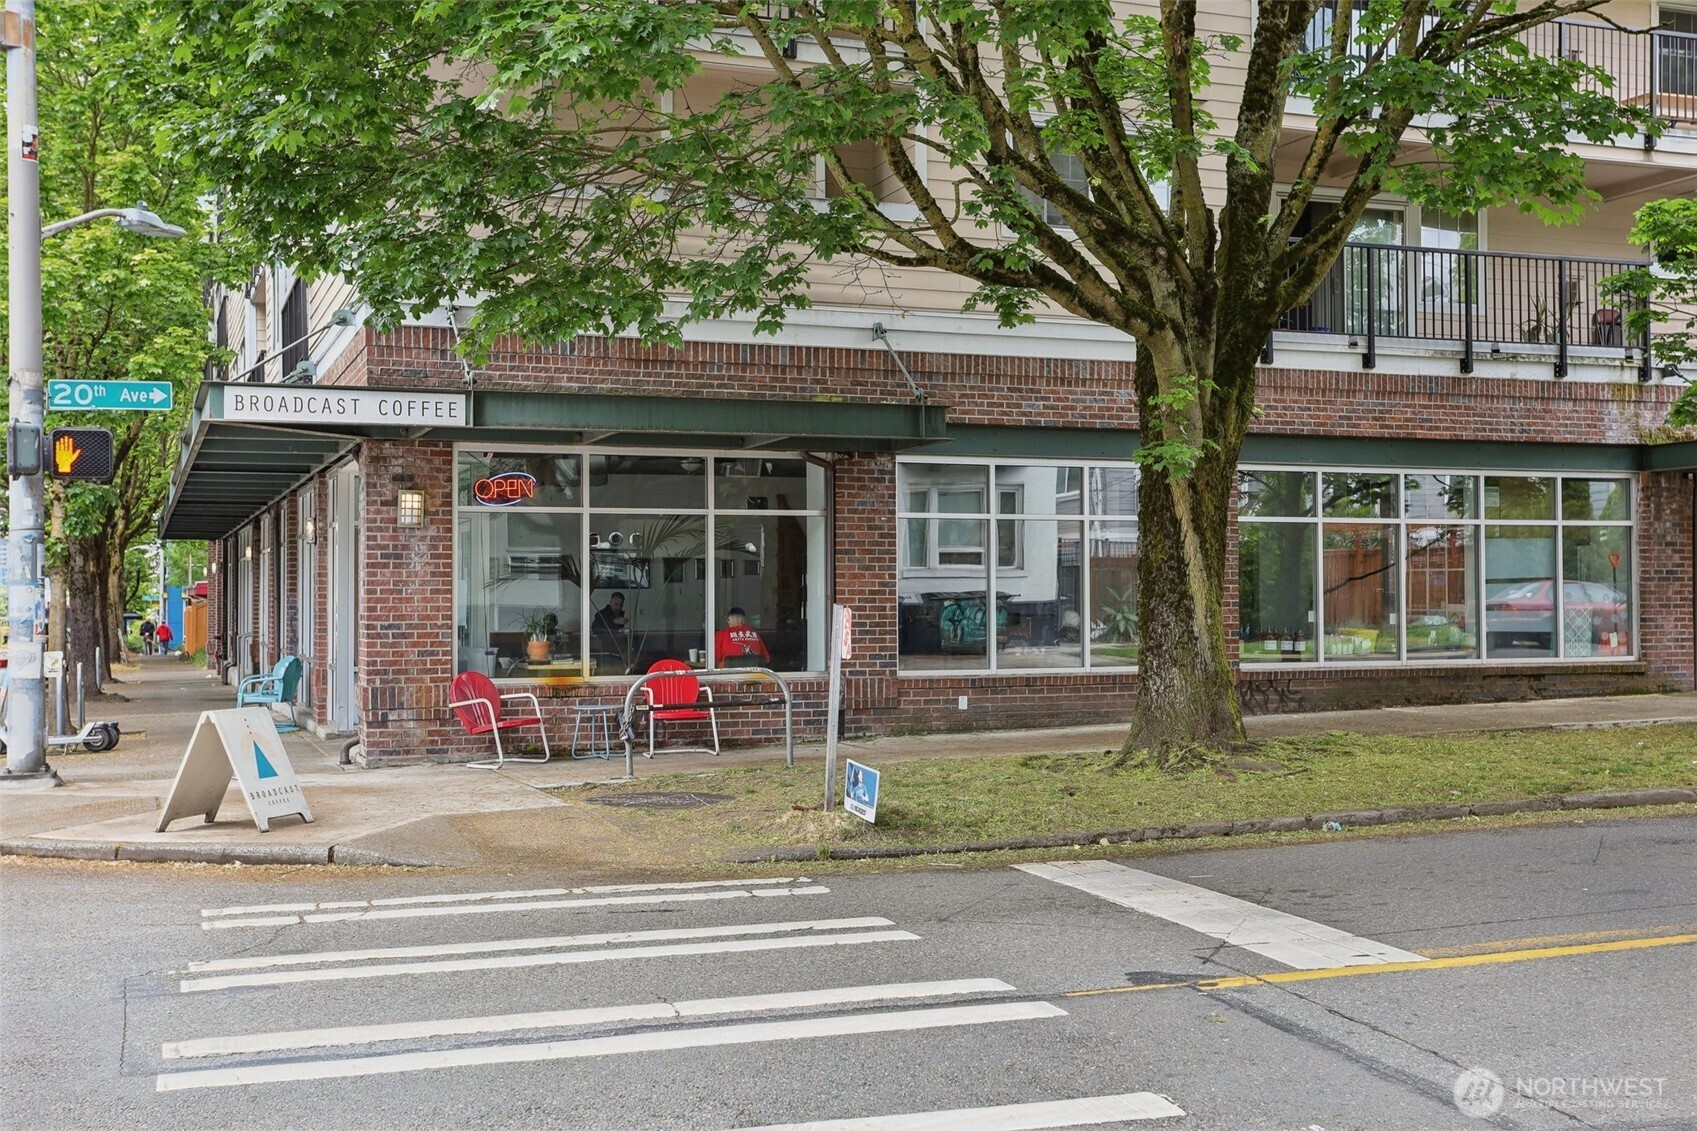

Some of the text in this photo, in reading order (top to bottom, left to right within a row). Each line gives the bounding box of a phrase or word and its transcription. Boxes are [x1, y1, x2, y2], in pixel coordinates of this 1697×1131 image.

[54, 383, 147, 405] 20th Ave
[234, 394, 458, 418] BROADCAST COFFEE
[474, 478, 535, 499] OPEN
[250, 784, 299, 800] BROADCAST
